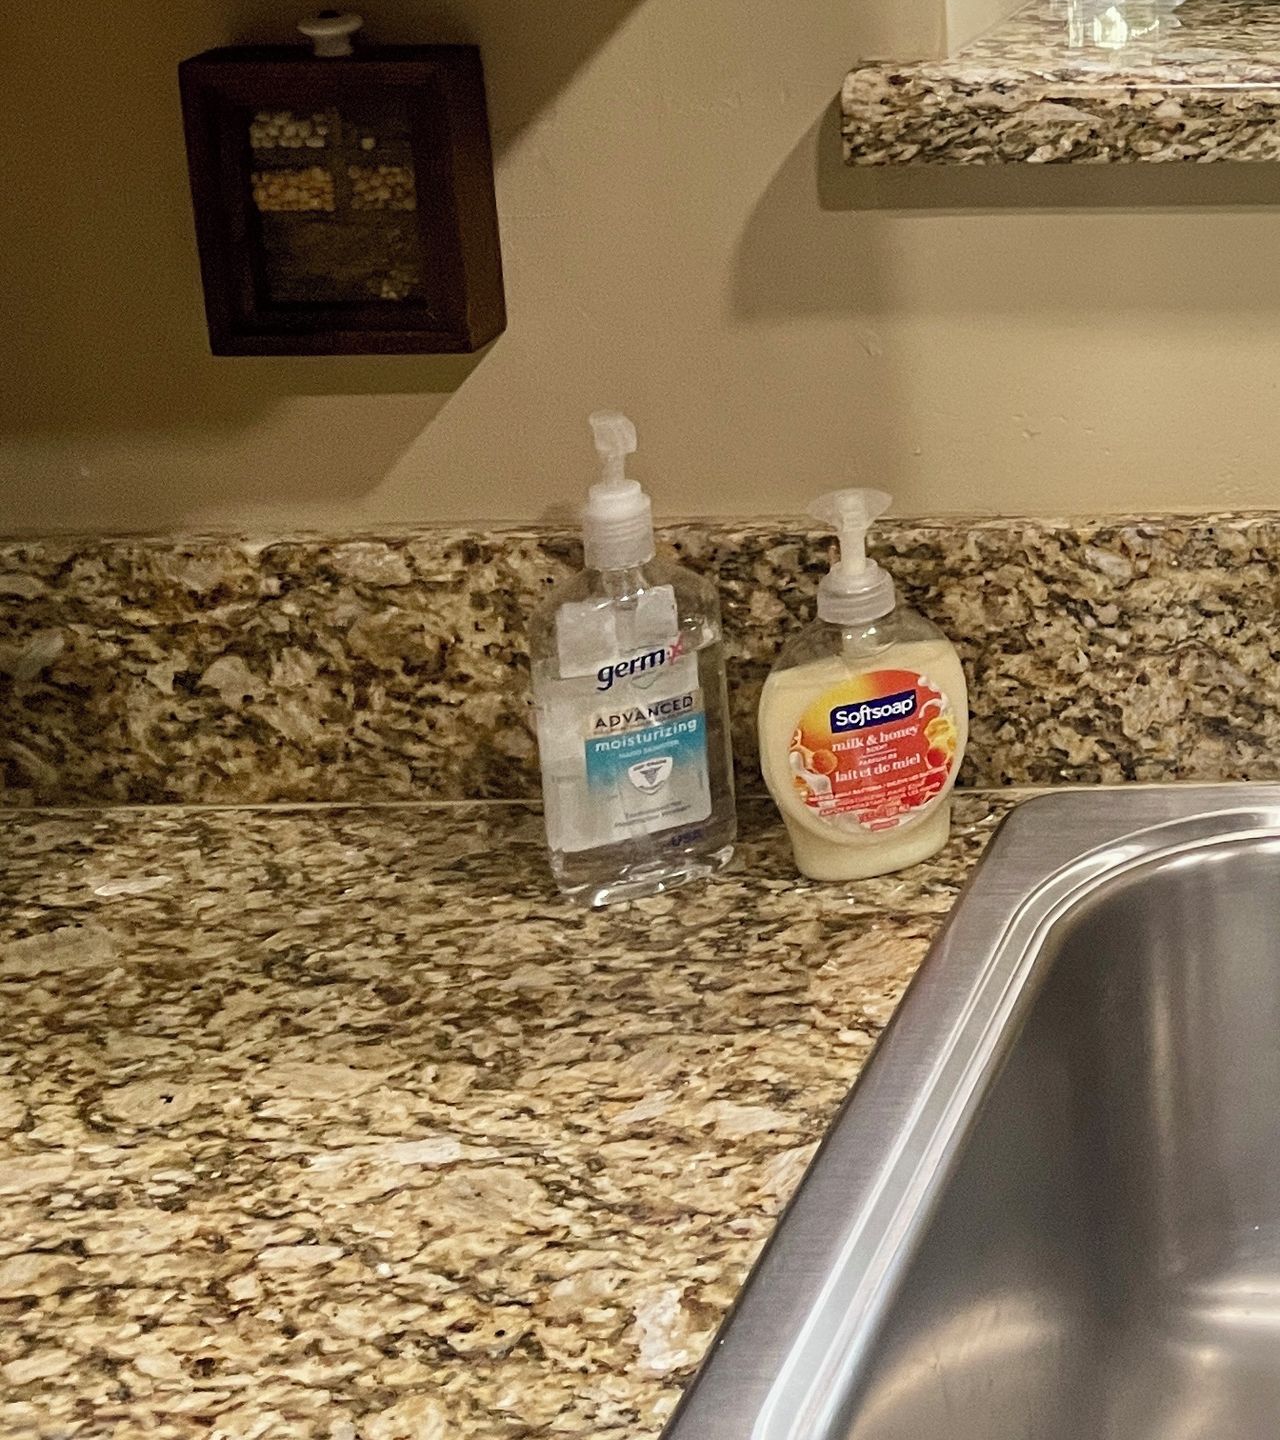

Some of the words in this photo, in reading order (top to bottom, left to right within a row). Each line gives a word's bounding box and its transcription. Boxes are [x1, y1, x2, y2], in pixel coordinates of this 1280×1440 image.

[595, 696, 693, 729] ADVANCED
[835, 698, 913, 726] Softsoap
[595, 719, 698, 752] moisturizing
[832, 737, 865, 752] milk
[866, 734, 878, 745] &
[880, 724, 919, 743] honey
[835, 768, 858, 782] lait
[859, 765, 872, 777] et
[873, 762, 890, 775] de
[892, 753, 921, 770] miel
